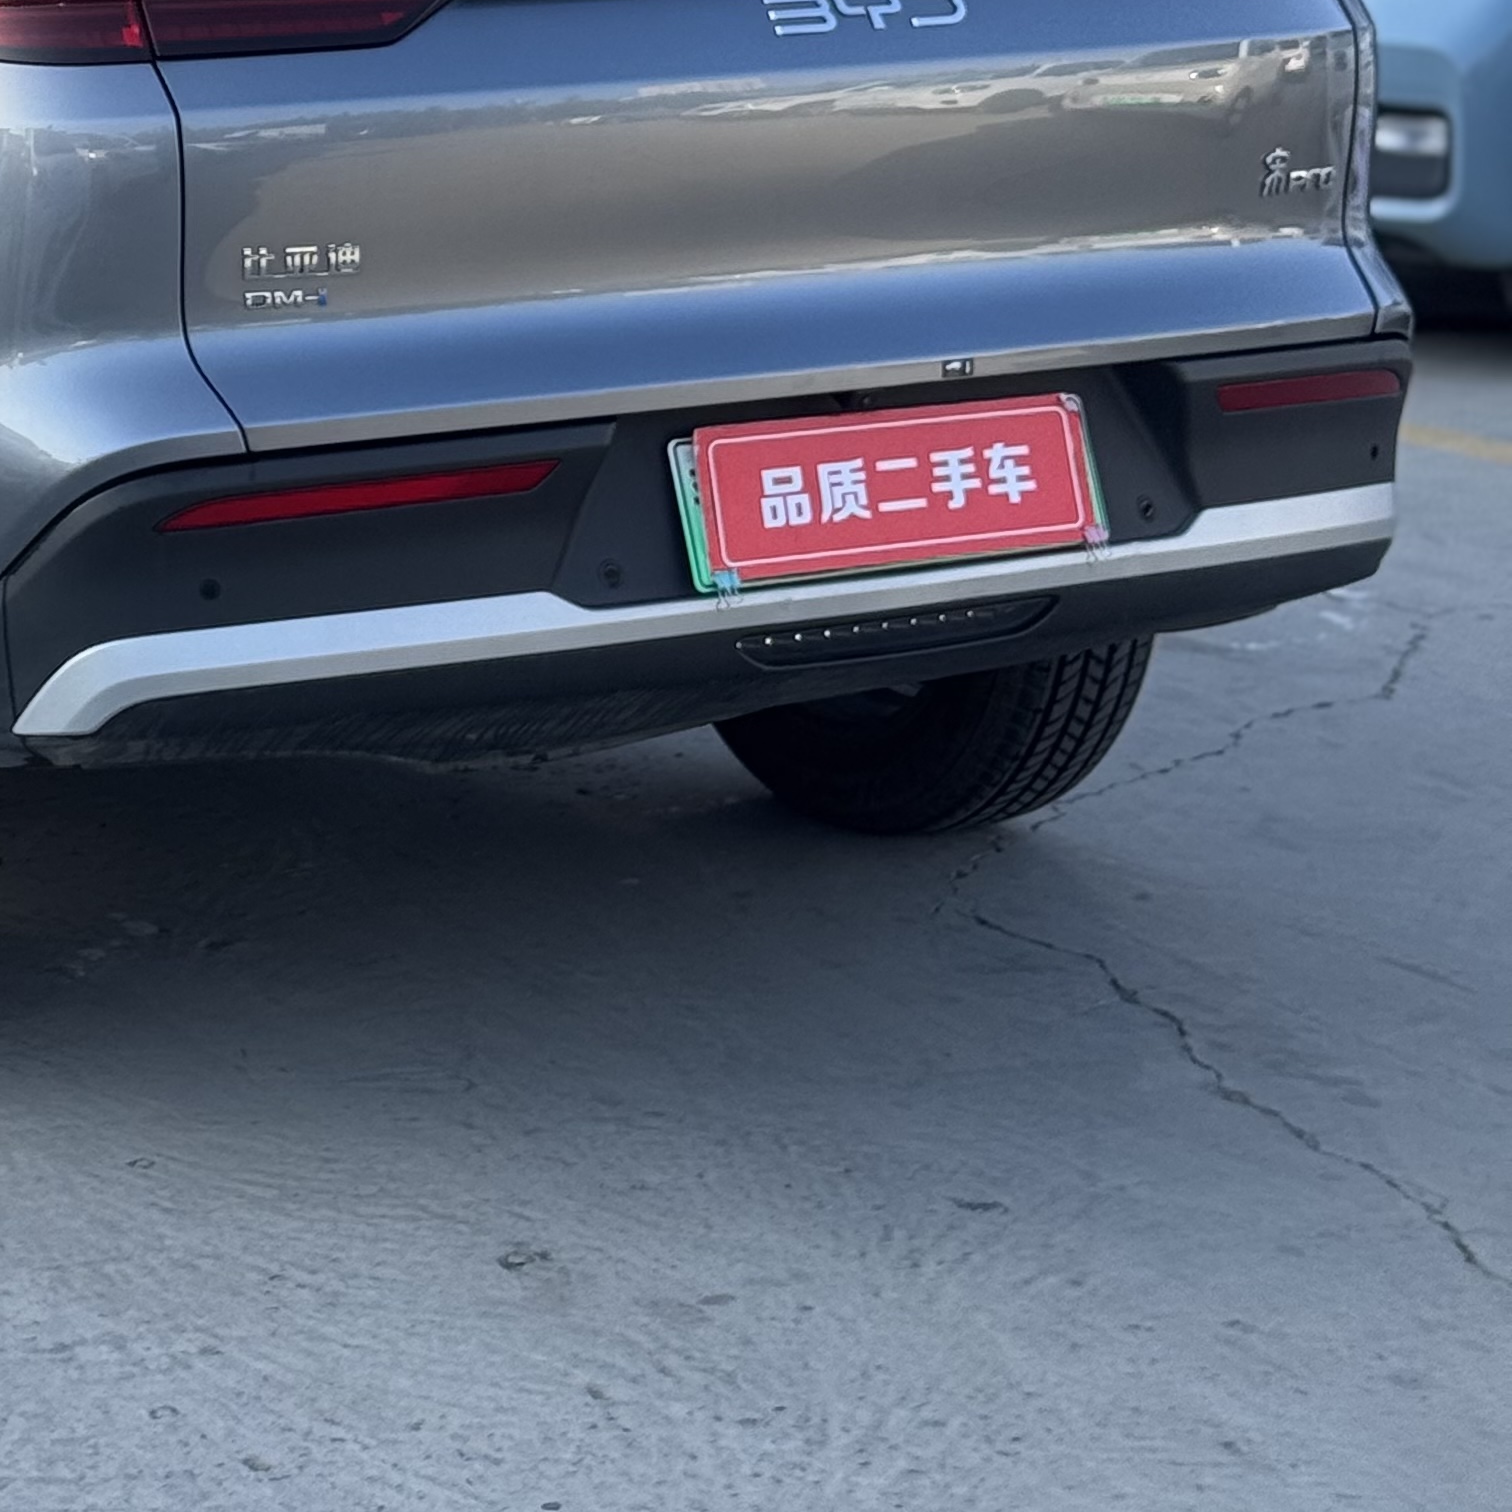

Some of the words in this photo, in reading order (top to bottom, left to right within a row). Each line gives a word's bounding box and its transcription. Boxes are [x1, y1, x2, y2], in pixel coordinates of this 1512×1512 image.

[760, 441, 1039, 530] 品质二手车
